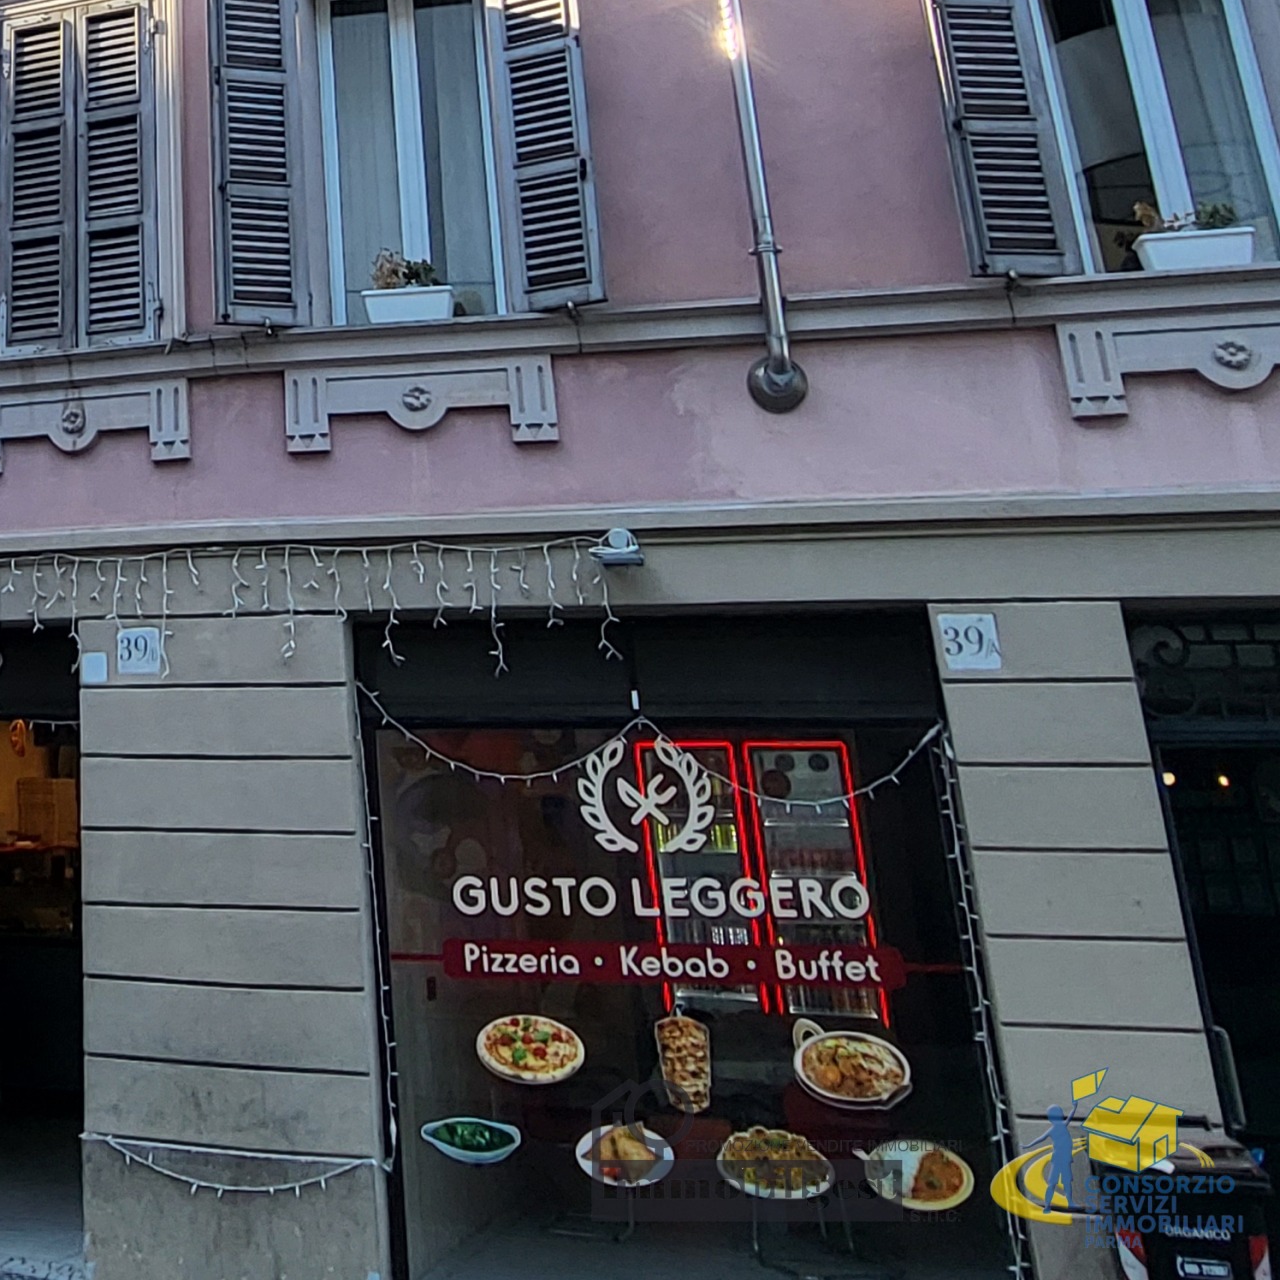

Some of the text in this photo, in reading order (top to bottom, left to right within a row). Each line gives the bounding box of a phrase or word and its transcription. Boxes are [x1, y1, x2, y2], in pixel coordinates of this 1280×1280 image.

[452, 875, 871, 919] GUSTO LEGGERO
[464, 942, 882, 982] Pizzeria Kebab Buffet
